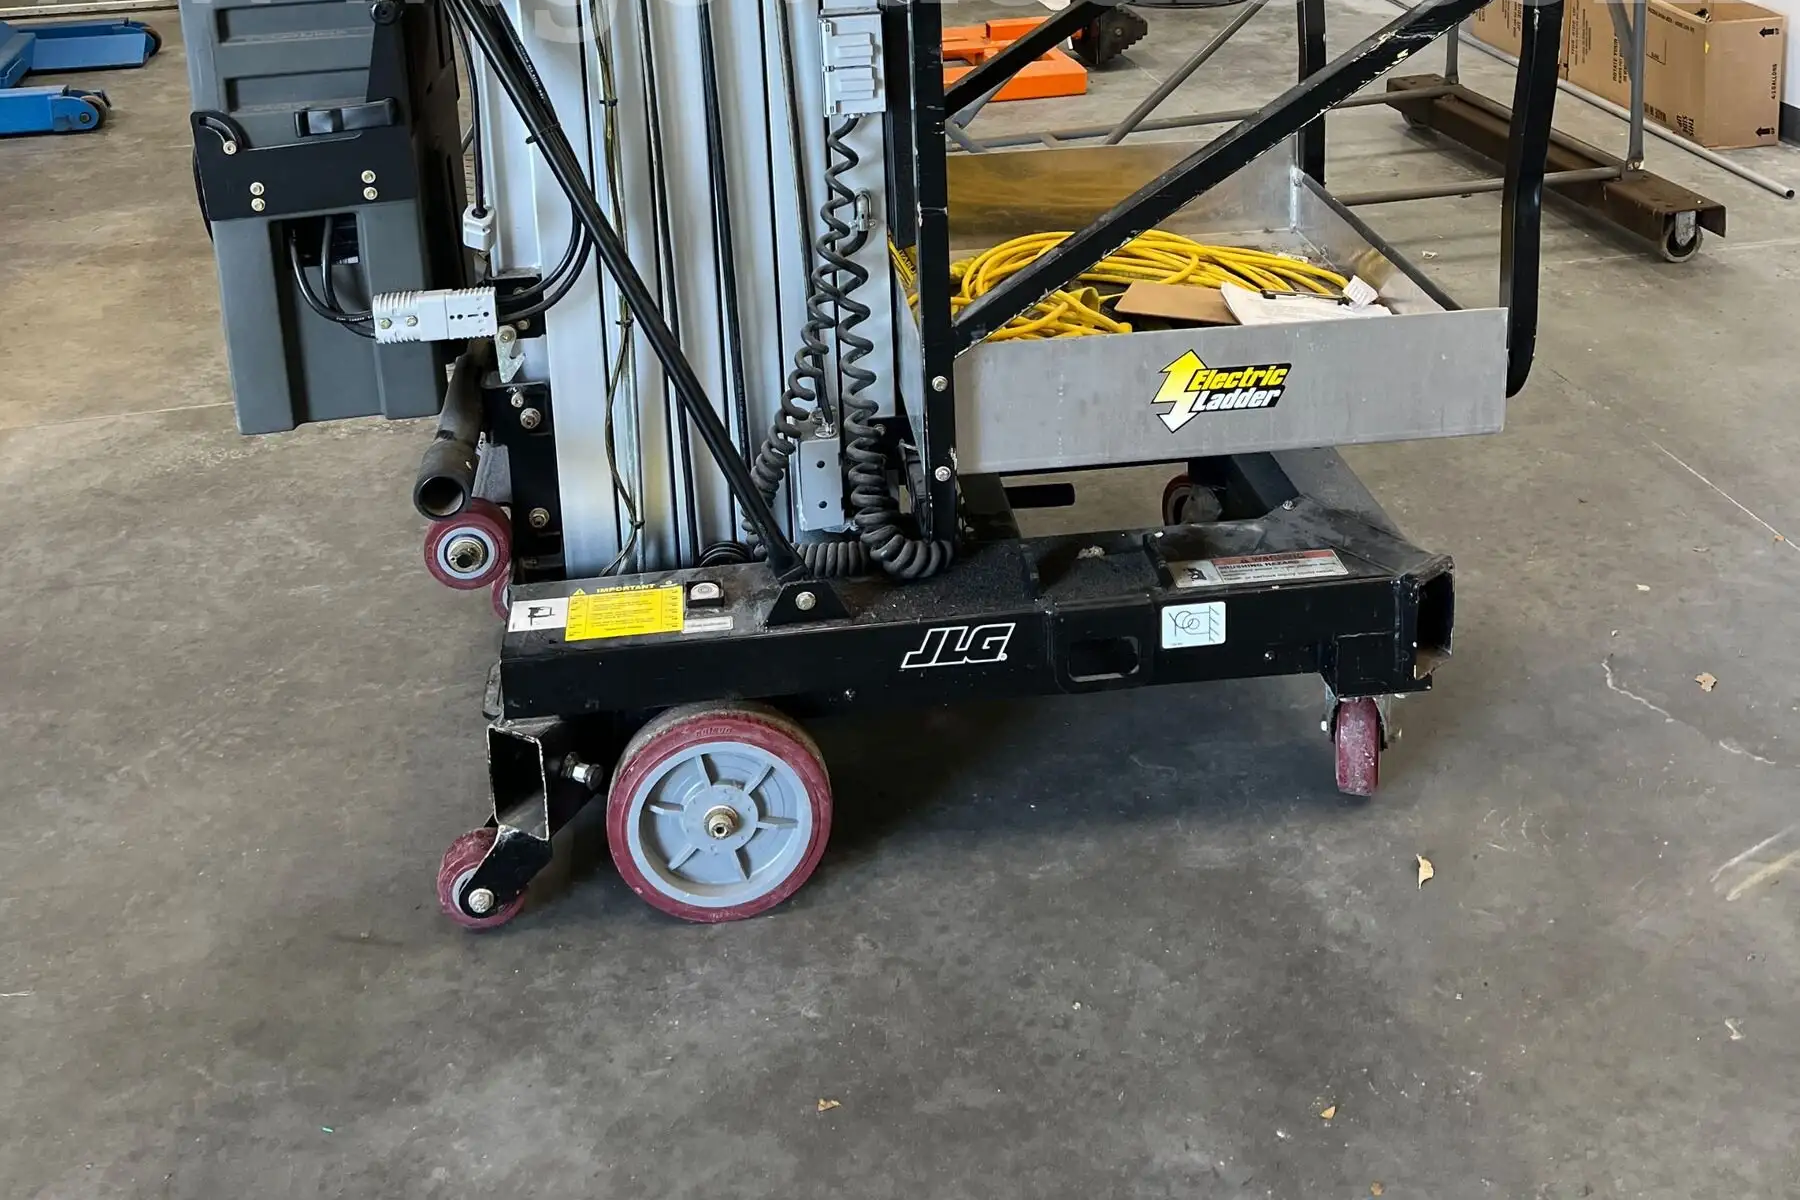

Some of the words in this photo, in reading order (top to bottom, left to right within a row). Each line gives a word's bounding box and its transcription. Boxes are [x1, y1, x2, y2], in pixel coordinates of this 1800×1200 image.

[1187, 366, 1288, 391] Electric
[1191, 388, 1281, 411] Ladder
[596, 583, 657, 594] IMPORTANT
[901, 622, 1017, 669] JLG
